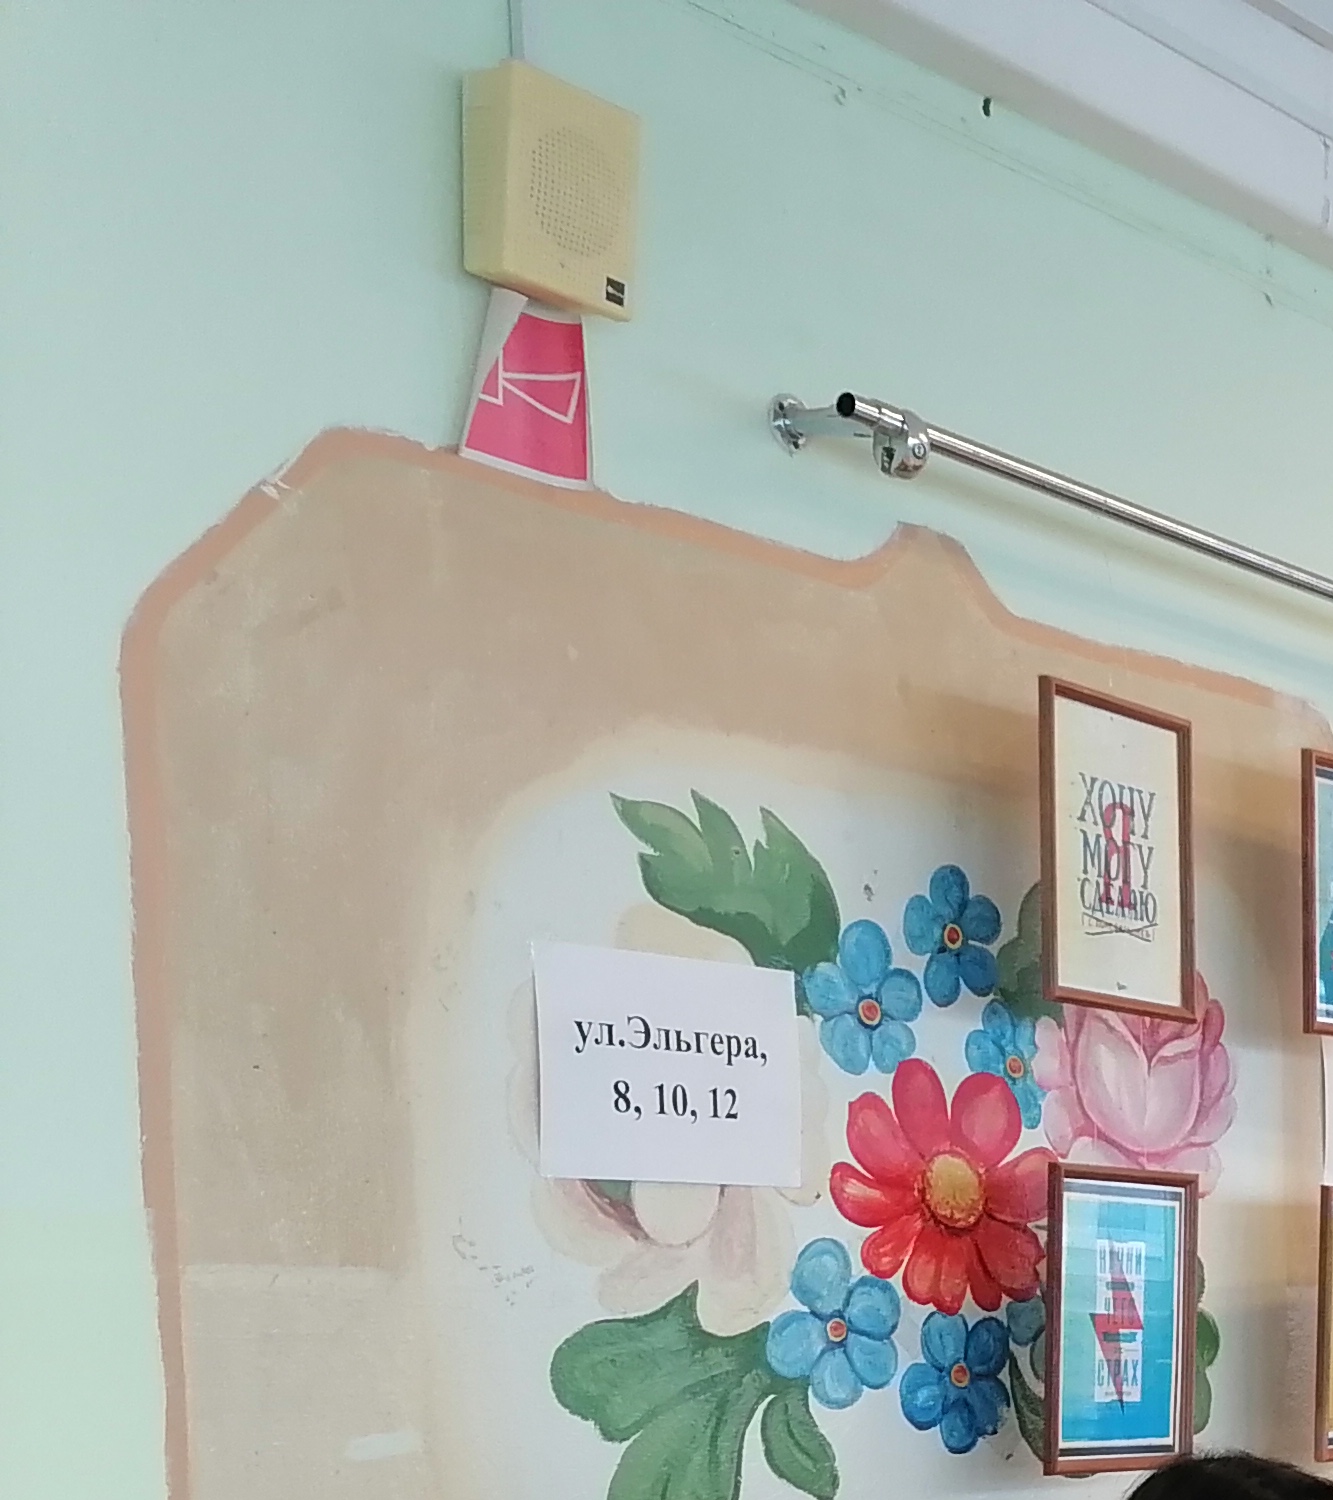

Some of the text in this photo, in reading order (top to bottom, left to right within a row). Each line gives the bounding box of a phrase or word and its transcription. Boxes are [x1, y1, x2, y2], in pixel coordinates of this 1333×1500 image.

[1077, 772, 1156, 840] ХОЧУ
[1080, 829, 1154, 890] МОГУ
[1080, 878, 1157, 923] СДЕЛАЮ
[574, 1015, 768, 1067] ул.Эльгера,
[613, 1080, 739, 1123] 8, 10, 12
[1097, 1359, 1138, 1387] СТРАХ
